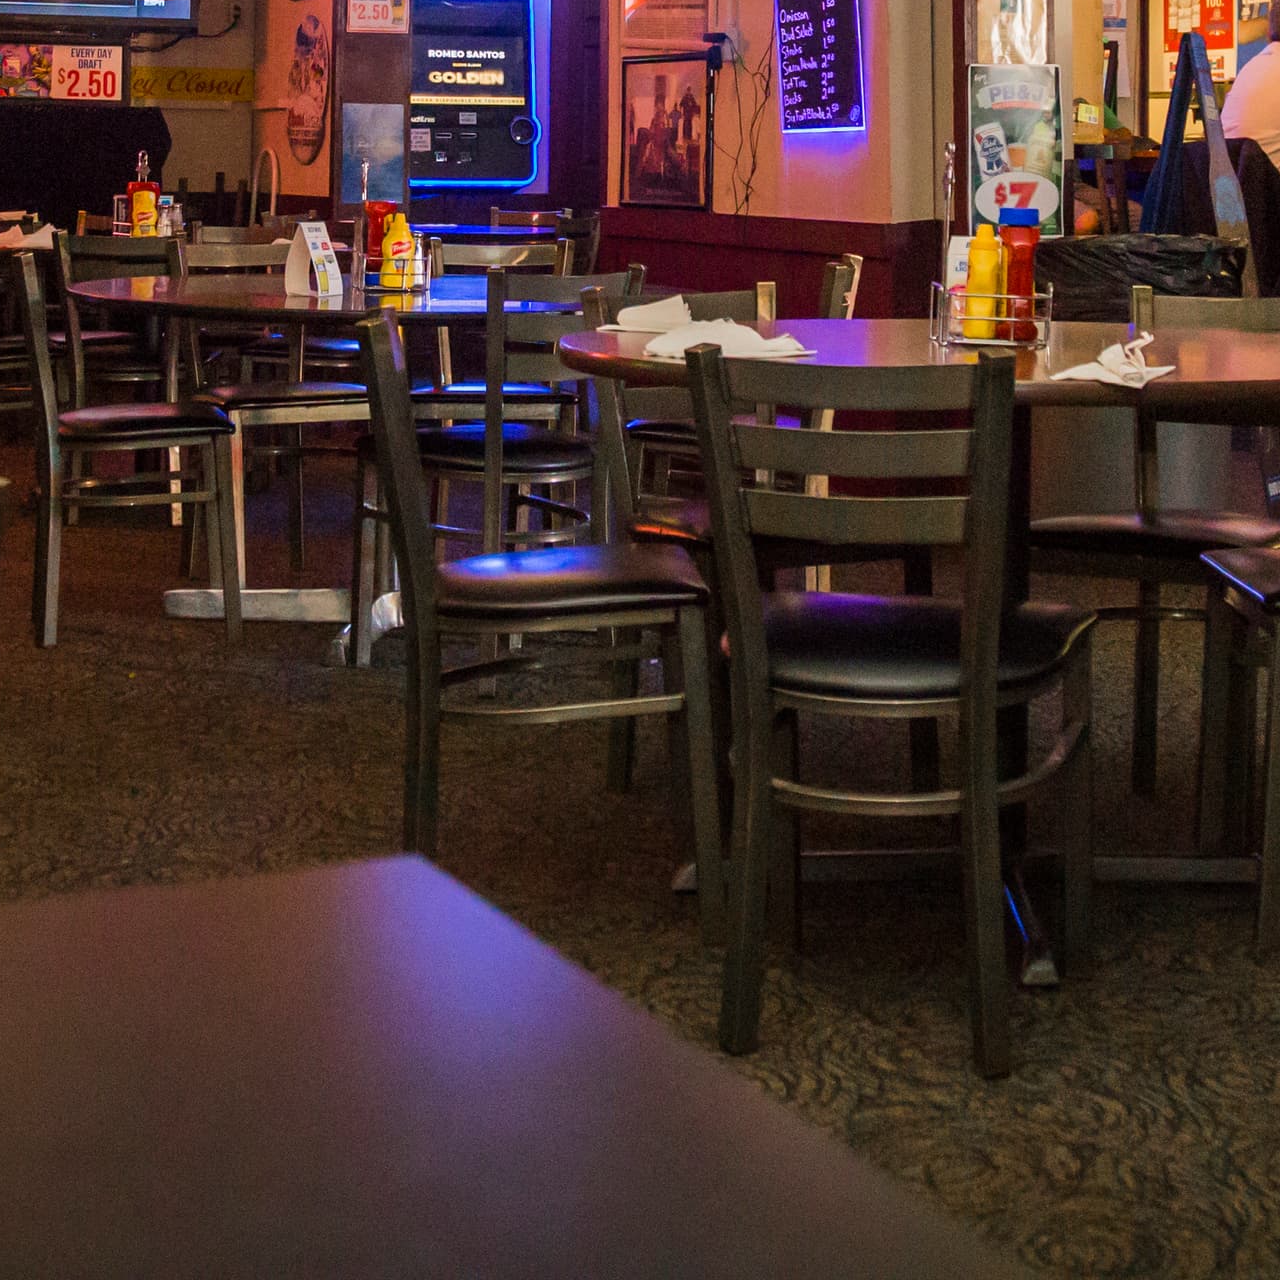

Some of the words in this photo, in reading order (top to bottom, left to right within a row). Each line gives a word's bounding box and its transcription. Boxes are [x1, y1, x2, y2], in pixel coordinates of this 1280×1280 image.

[352, 3, 389, 20] $2.50
[780, 27, 795, 43] Bud
[71, 47, 94, 58] EVERY
[97, 48, 113, 59] DAY
[427, 49, 465, 59] ROMEO
[466, 50, 506, 59] SANTOS
[78, 59, 102, 69] DRAFT
[57, 67, 117, 98] $2.50
[132, 76, 158, 96] ey
[166, 70, 245, 96] Closed
[428, 70, 505, 86] GOLDEN
[990, 86, 1044, 103] PB&J
[994, 181, 1039, 208] $7
